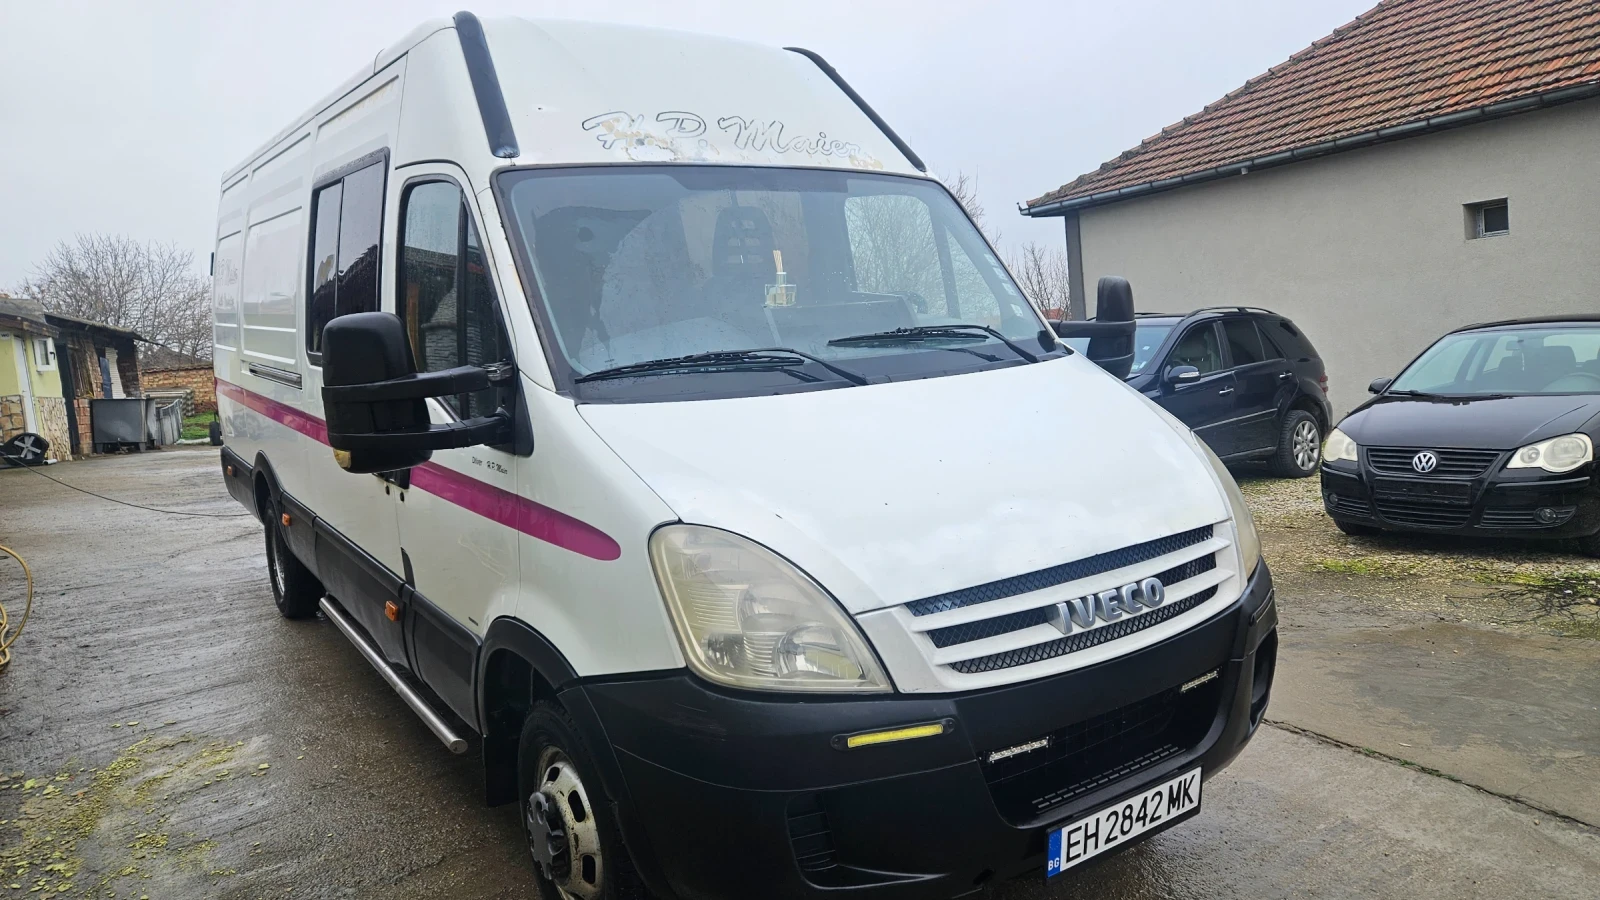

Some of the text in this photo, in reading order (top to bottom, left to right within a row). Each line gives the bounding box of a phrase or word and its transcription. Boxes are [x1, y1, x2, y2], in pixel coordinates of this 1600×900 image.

[1054, 577, 1165, 635] IVECO
[1066, 774, 1196, 864] EH 2842 MK
[1048, 857, 1060, 871] BG
